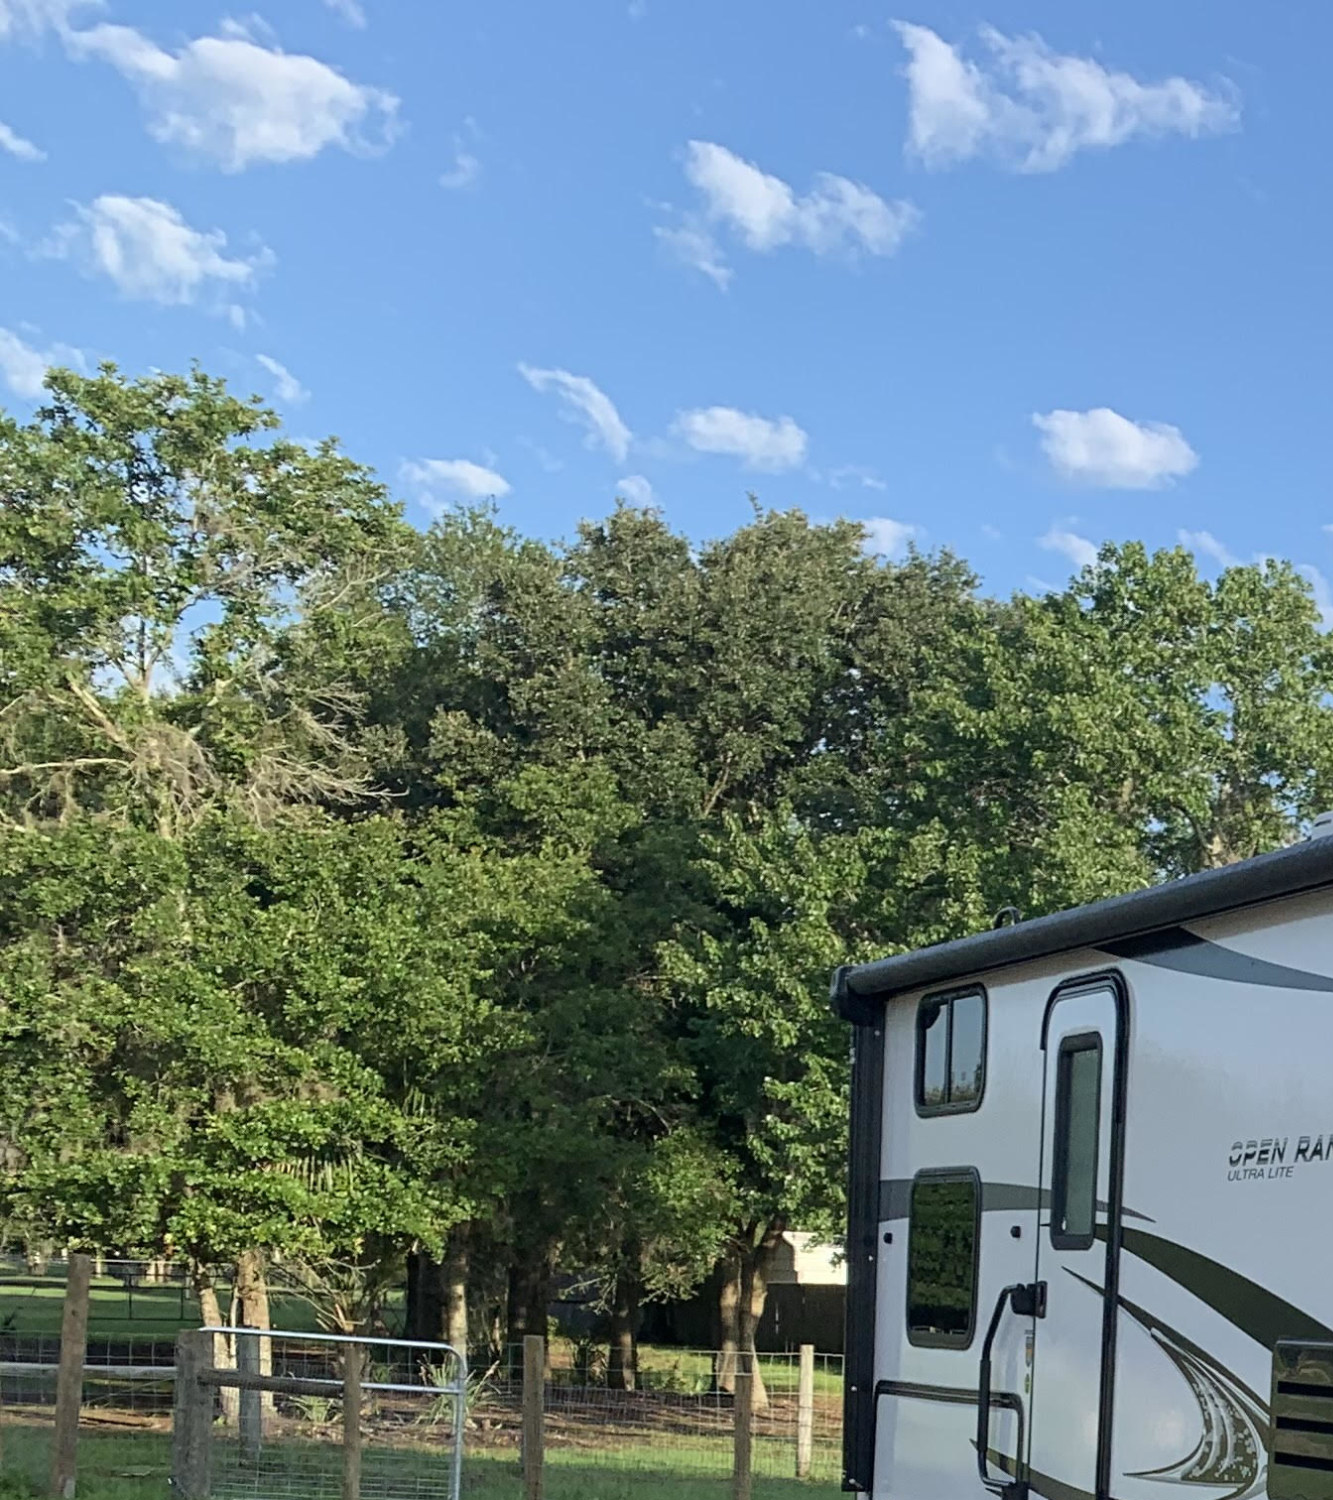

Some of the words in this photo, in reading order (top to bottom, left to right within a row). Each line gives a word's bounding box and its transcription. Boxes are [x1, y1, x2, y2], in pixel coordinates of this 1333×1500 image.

[1229, 1137, 1288, 1167] OPEN
[1227, 1167, 1264, 1181] ULTRA
[1268, 1166, 1294, 1179] LITE
